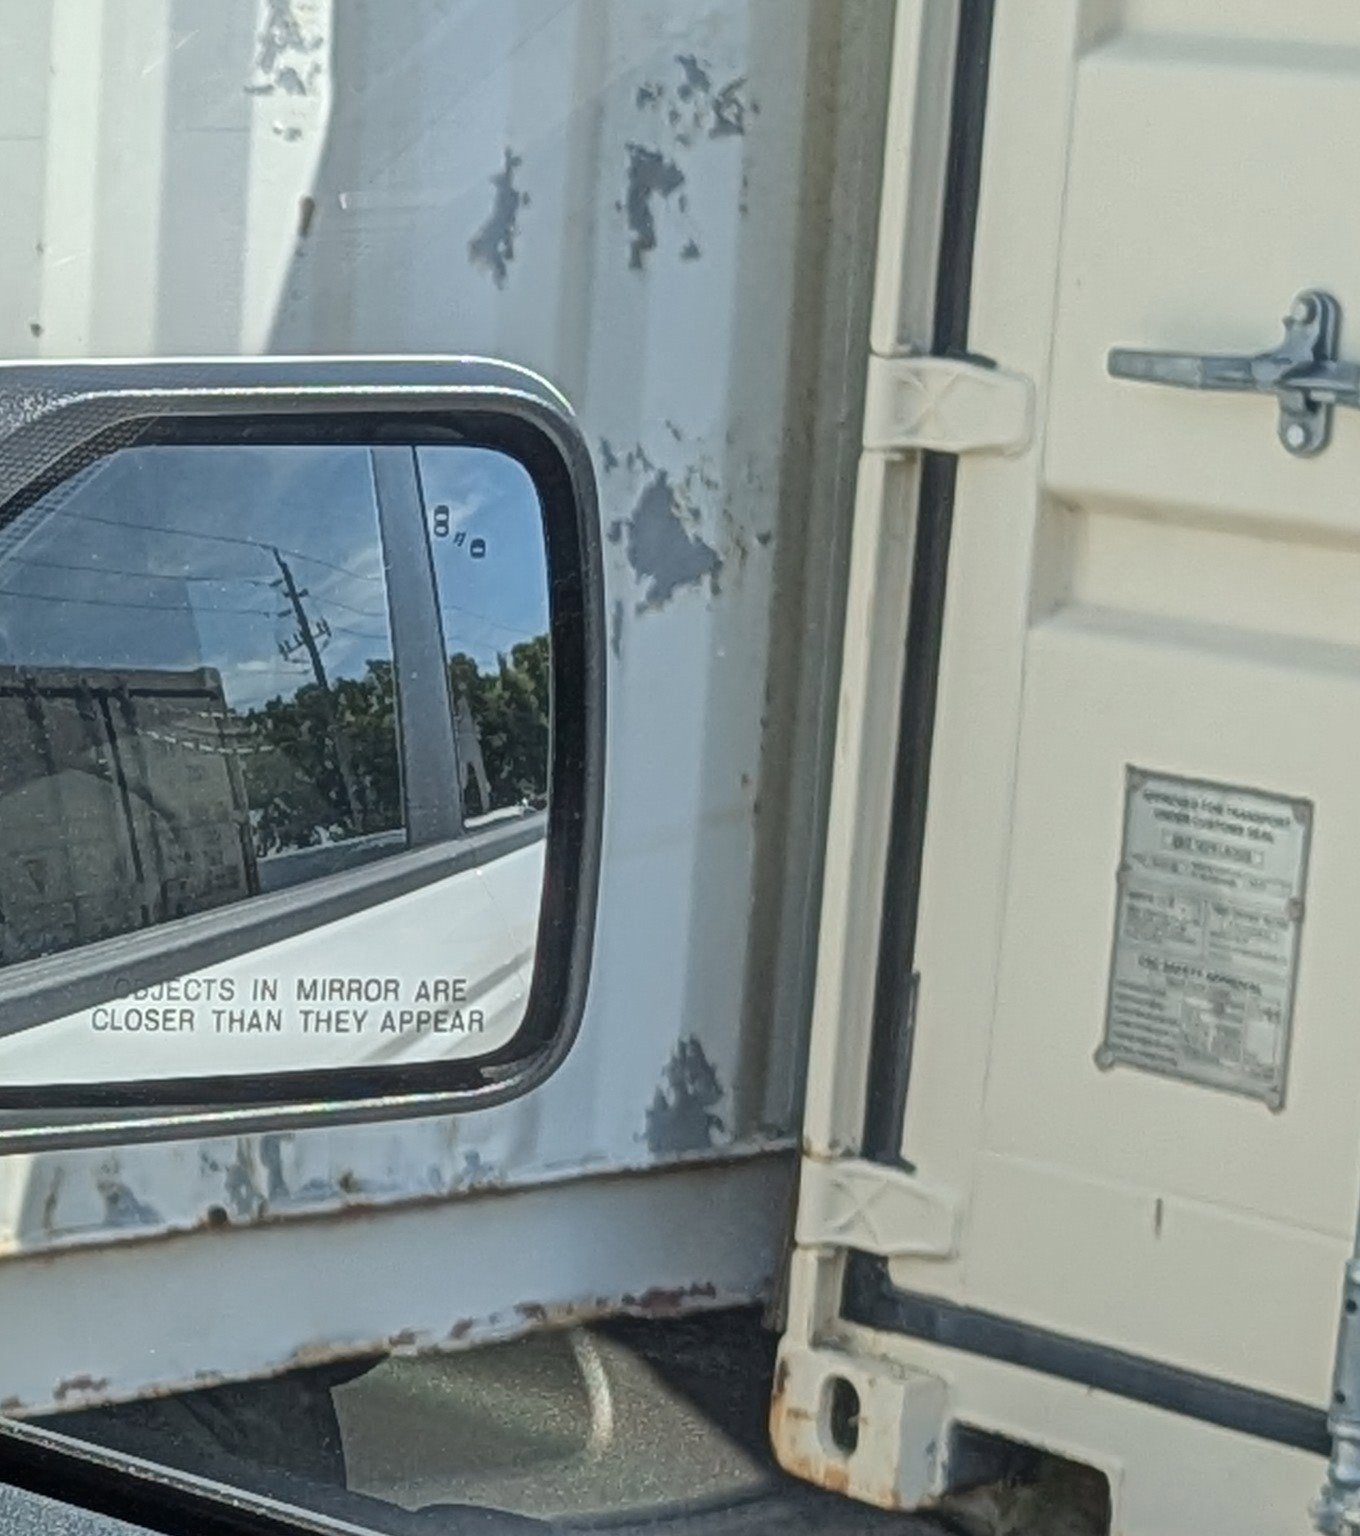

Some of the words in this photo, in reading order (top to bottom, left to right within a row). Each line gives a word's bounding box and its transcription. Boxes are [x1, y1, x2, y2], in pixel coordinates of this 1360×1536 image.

[252, 979, 278, 1001] IN
[297, 978, 400, 1002] MIRROR
[414, 978, 468, 1001] ARE
[91, 1009, 195, 1032] CLOSER
[213, 1010, 282, 1032] THAN
[300, 1010, 366, 1033] THEY
[380, 1010, 485, 1033] APPEAR
